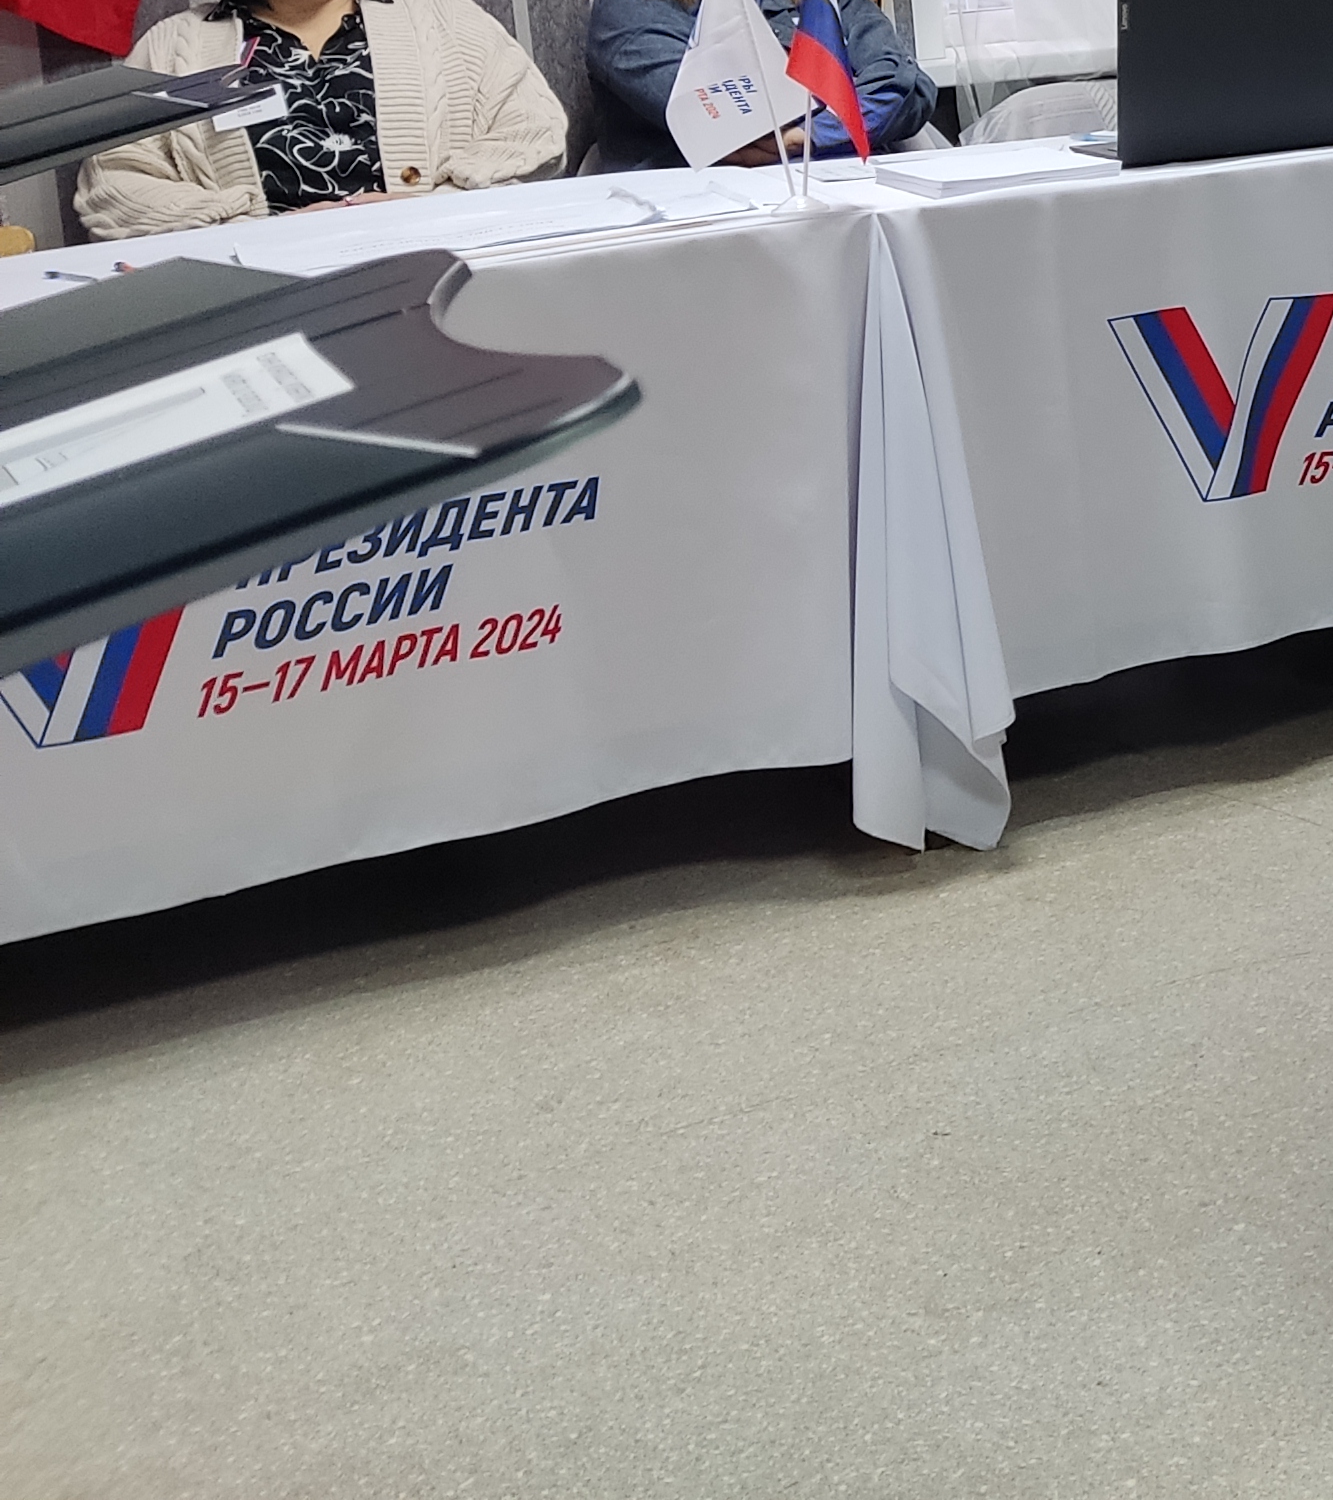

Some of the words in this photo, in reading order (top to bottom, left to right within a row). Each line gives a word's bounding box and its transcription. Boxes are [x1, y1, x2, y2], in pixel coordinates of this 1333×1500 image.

[212, 564, 454, 659] РОССИИ
[320, 624, 461, 692] МАРТА
[469, 604, 563, 660] 2024
